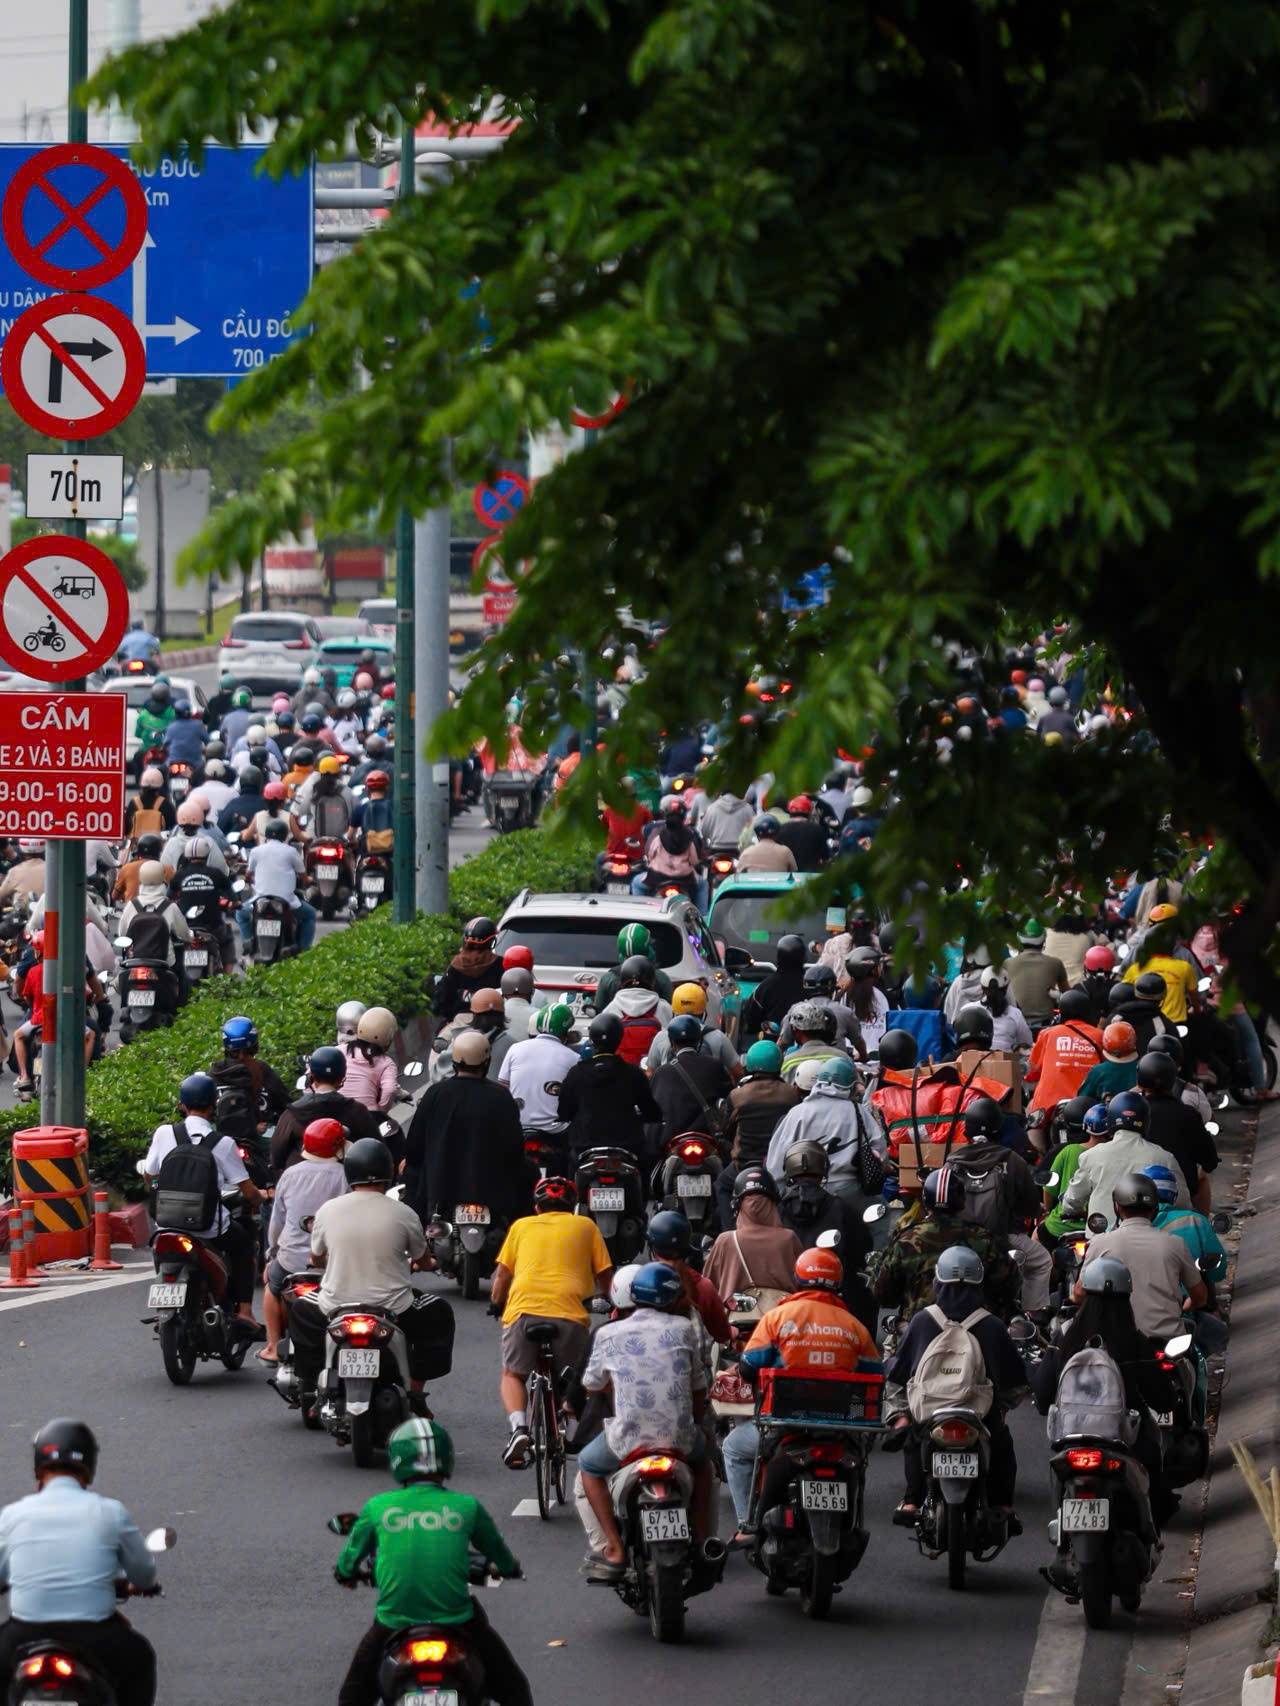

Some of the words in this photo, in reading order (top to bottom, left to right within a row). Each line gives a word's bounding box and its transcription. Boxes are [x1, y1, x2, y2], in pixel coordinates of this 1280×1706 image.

[223, 308, 261, 337] CẦU
[233, 348, 264, 367] 700
[21, 697, 90, 730] CẤM
[15, 746, 25, 766] 2
[29, 739, 51, 767] VÀ
[56, 747, 66, 767] 3
[71, 740, 120, 767] BÁNH
[346, 1352, 374, 1364] 59-Y2
[342, 1365, 377, 1376] 812.32
[941, 1454, 971, 1465] 81-AD
[935, 1465, 976, 1476] 006.72
[810, 1483, 840, 1495] 50-N1
[807, 1495, 846, 1509] 345.69
[1070, 1501, 1101, 1514] 77-M1
[382, 1505, 464, 1532] Grab
[649, 1510, 680, 1524] 67-G1
[1066, 1515, 1107, 1528] 124.83
[646, 1526, 687, 1540] 512.46
